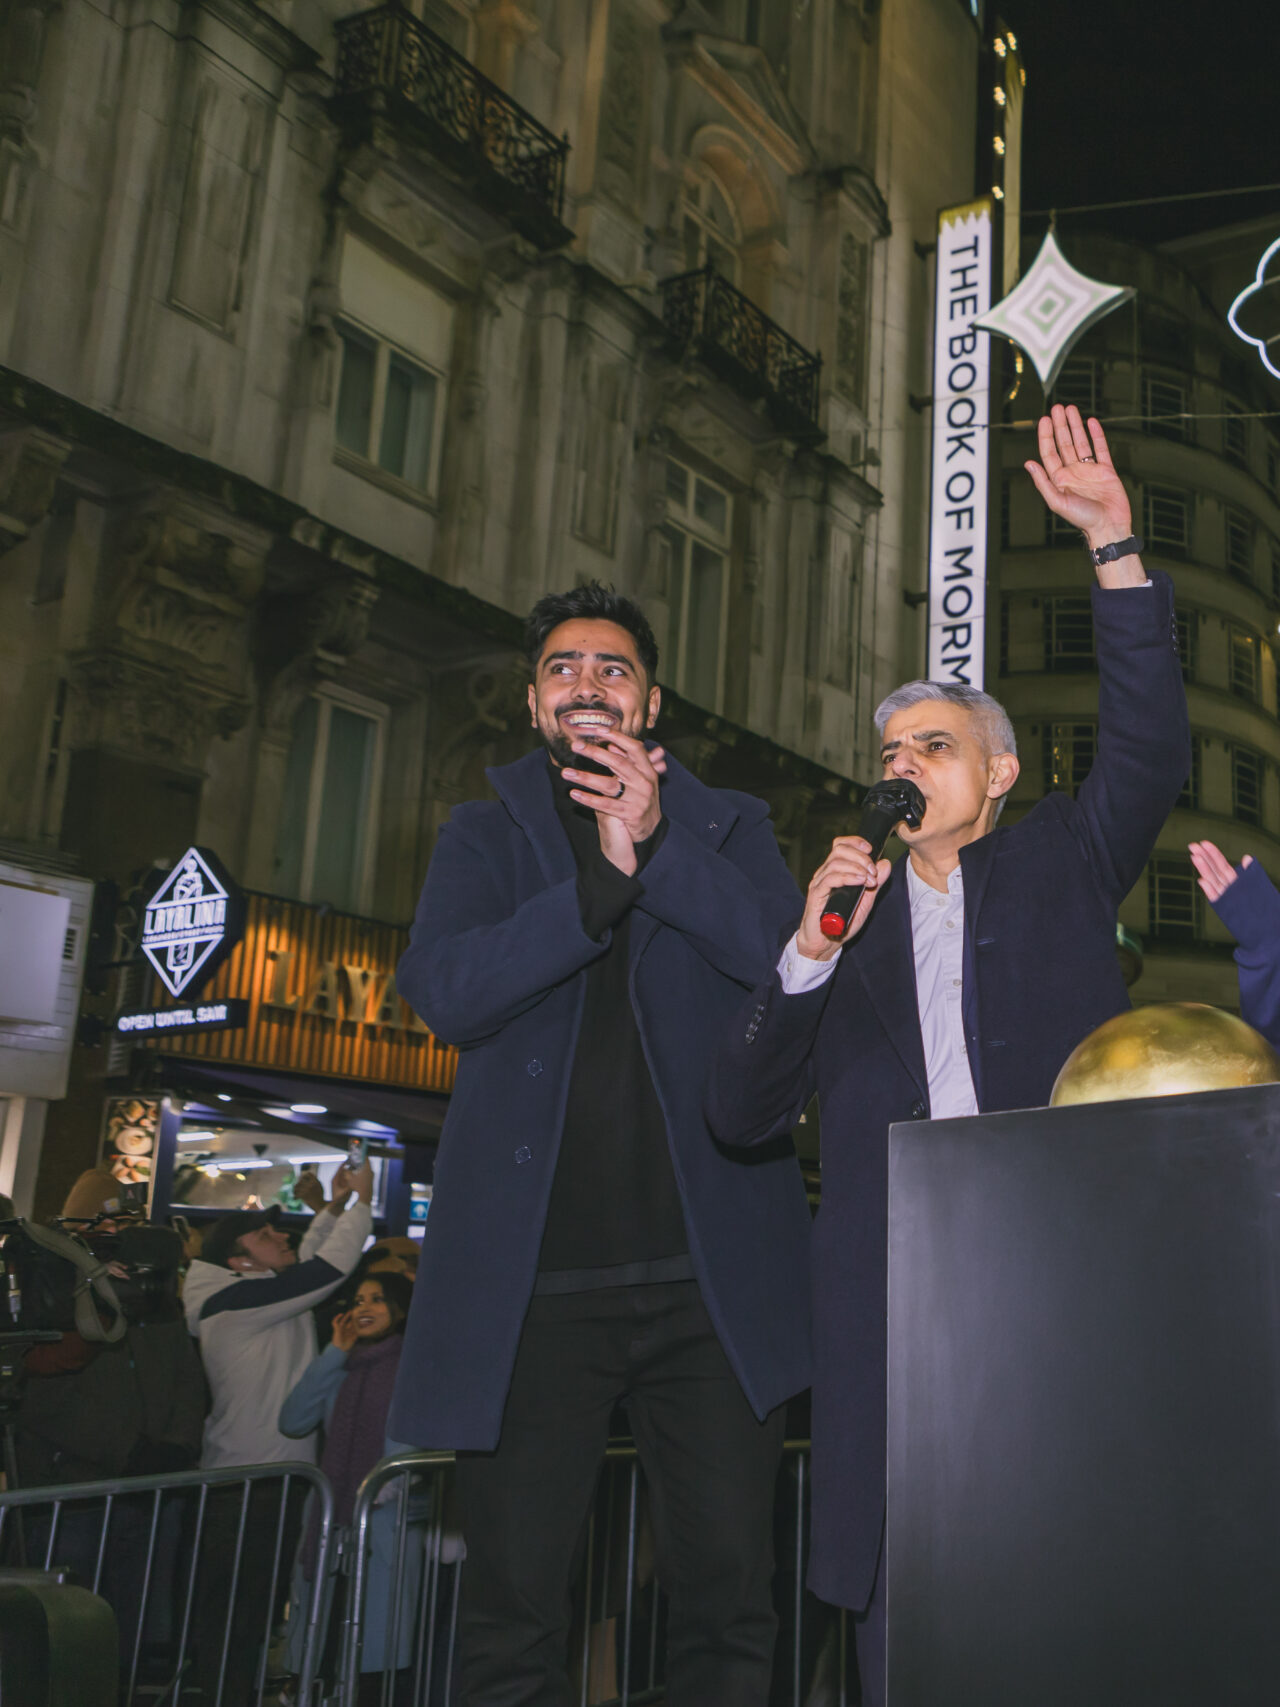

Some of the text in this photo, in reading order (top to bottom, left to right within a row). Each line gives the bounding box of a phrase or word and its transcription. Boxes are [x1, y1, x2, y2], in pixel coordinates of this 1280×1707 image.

[950, 235, 979, 321] THE
[946, 328, 977, 462] BOOK
[945, 471, 975, 530] OF
[143, 899, 227, 935] LAYALINA
[117, 1013, 155, 1032] OPEN
[155, 1009, 197, 1028] UNTIL
[261, 950, 435, 1034] LAYA
